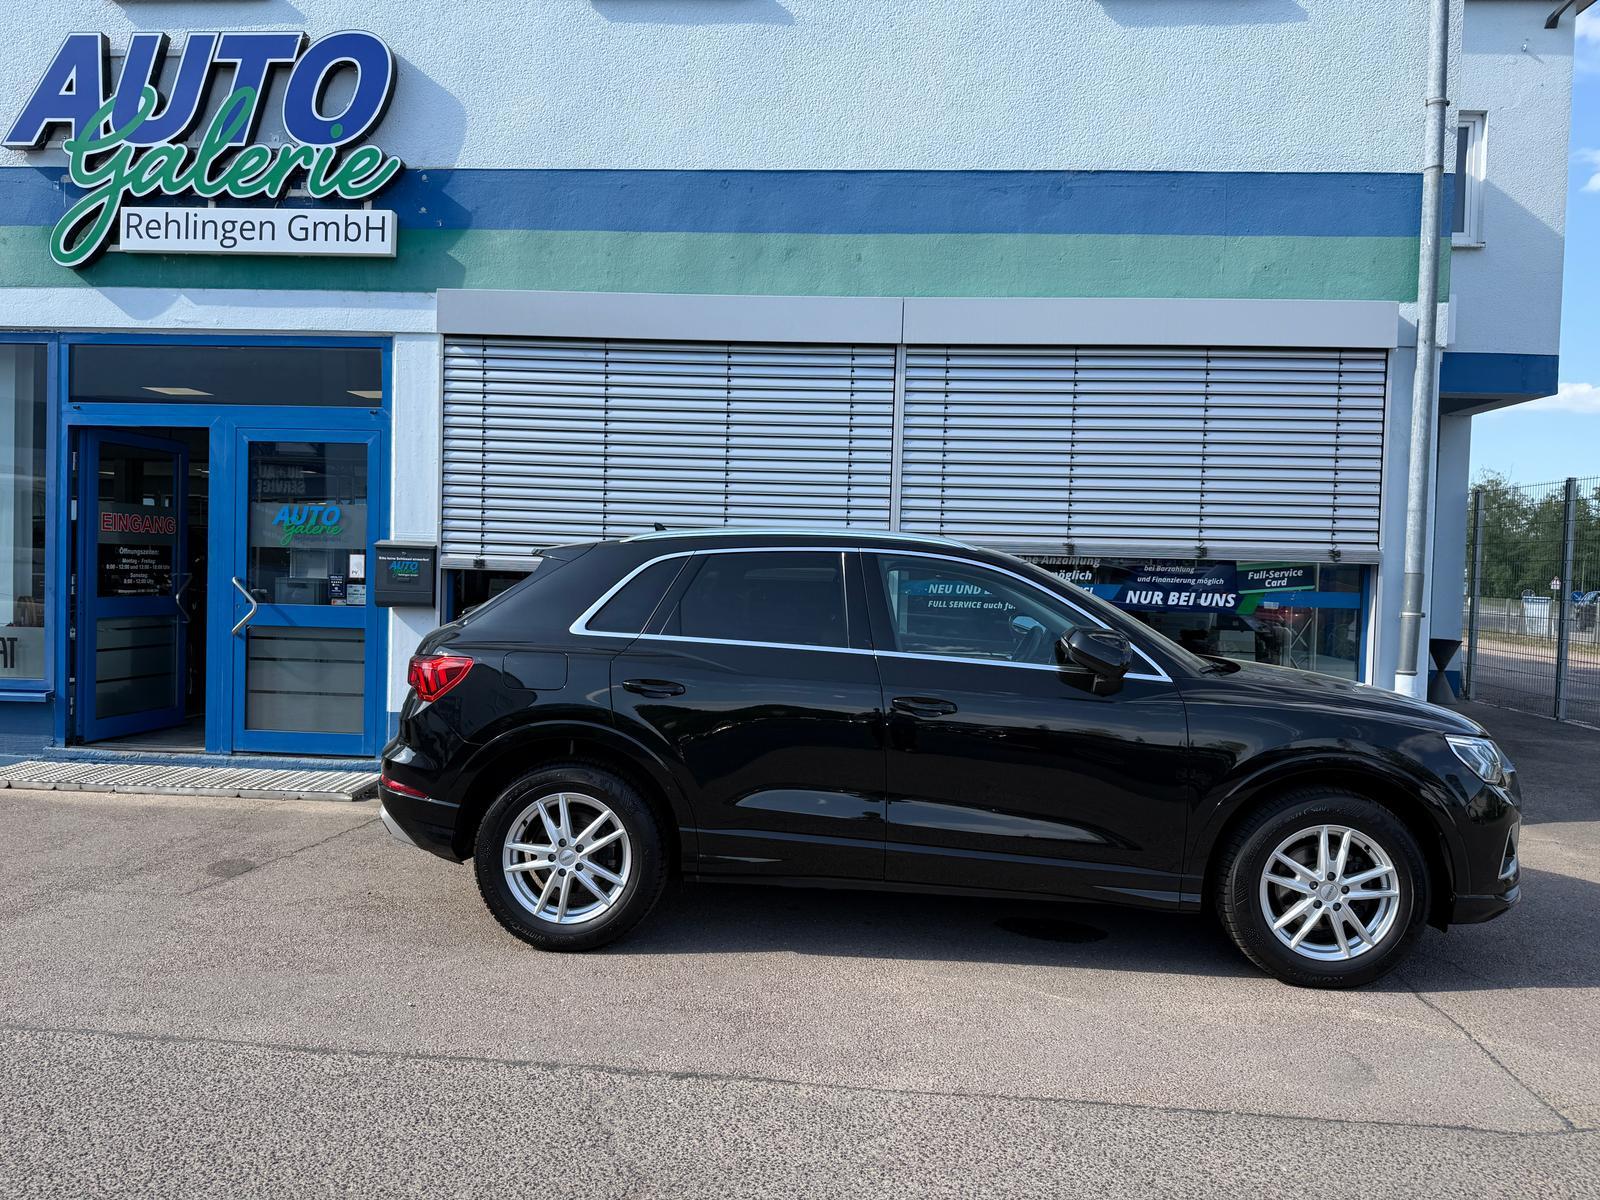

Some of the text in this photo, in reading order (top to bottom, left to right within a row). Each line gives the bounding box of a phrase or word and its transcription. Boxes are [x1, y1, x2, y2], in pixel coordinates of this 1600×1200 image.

[1, 30, 396, 150] AUTO
[49, 85, 402, 267] Galerie
[125, 212, 387, 249] Rehlingen GmbH
[272, 505, 341, 526] AUTO
[101, 512, 176, 534] EINGANG
[1041, 555, 1101, 568] Anzahlung
[1156, 565, 1195, 574] Barzahlung
[1248, 568, 1304, 580] Full-Service
[1152, 576, 1196, 585] Finanzierung
[1196, 577, 1224, 586] möglich
[1265, 578, 1288, 588] Card
[928, 584, 954, 595] NEU
[956, 584, 982, 595] UND
[949, 600, 982, 609] SERVICE
[983, 601, 1003, 609] auch
[1126, 590, 1236, 608] NUR BEI UNS
